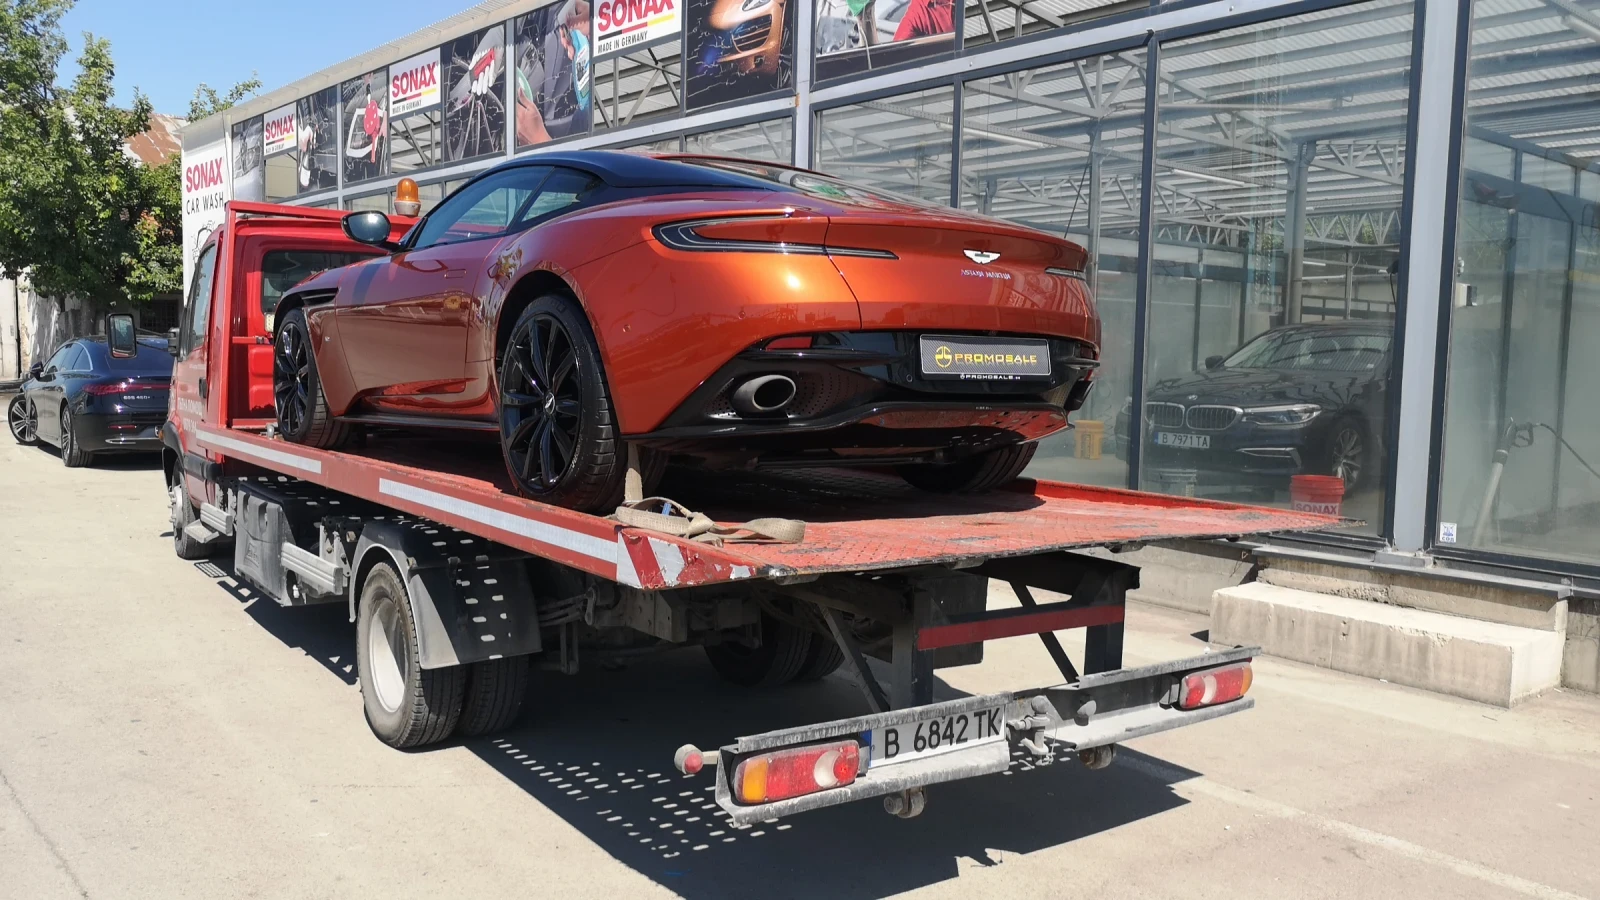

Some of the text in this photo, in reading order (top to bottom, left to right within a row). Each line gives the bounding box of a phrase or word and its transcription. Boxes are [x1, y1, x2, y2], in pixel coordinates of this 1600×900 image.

[597, 30, 648, 54] MADE IN GERMANY
[392, 61, 437, 98] SONAX
[265, 113, 294, 141] SONAX
[186, 156, 224, 193] SONAX
[186, 191, 224, 216] CAR WASH
[954, 352, 1038, 364] PROMOSALE
[1162, 433, 1208, 448] B 7971 TA
[1295, 503, 1338, 515] SONAX
[884, 707, 1001, 760] B 6842 TK
